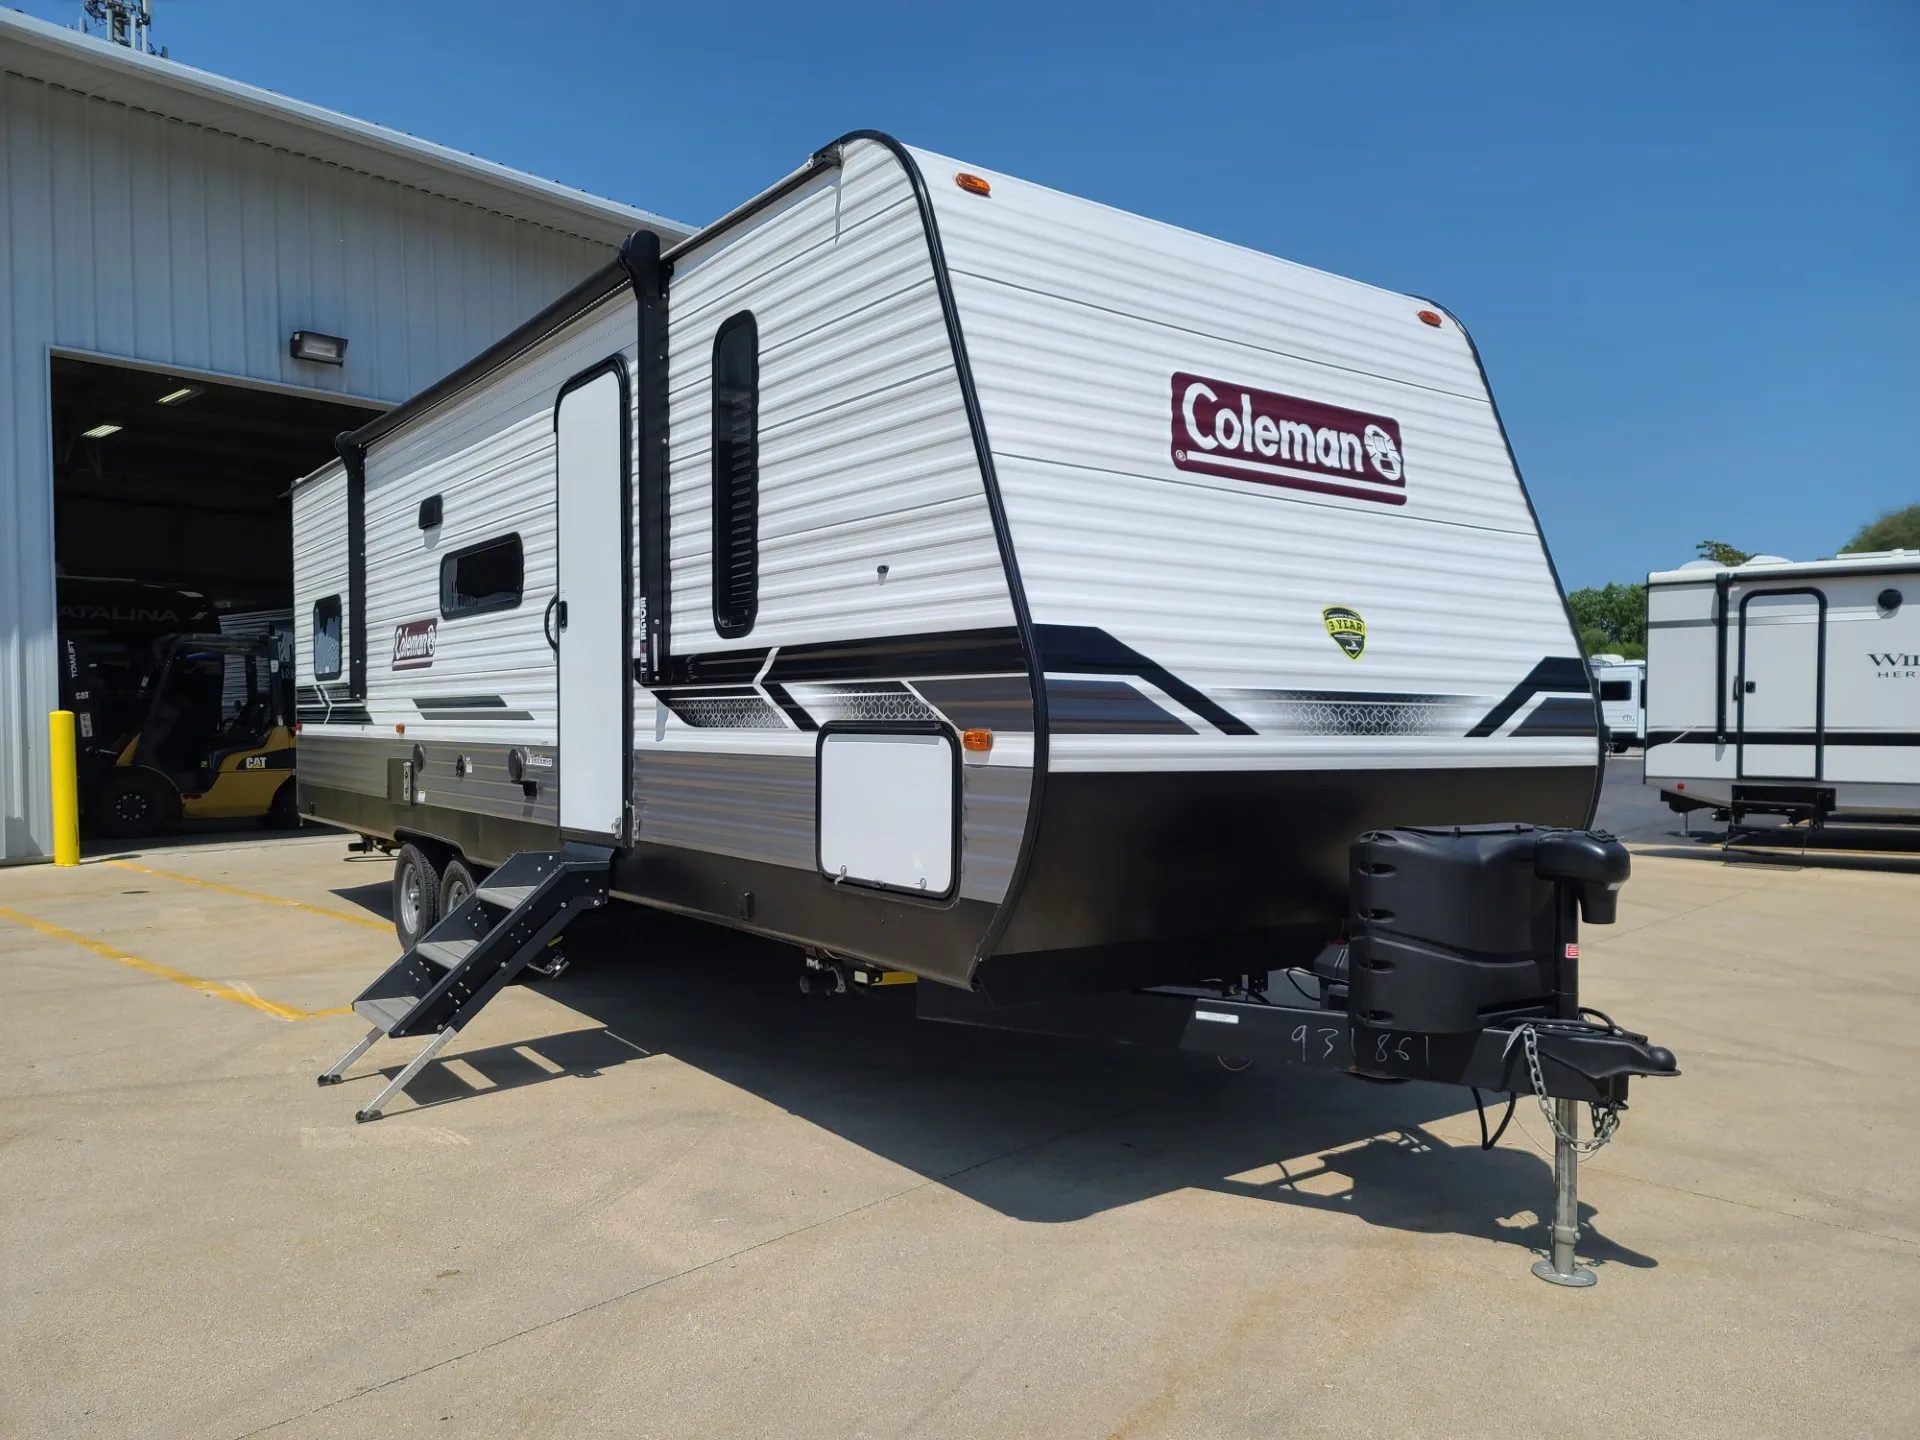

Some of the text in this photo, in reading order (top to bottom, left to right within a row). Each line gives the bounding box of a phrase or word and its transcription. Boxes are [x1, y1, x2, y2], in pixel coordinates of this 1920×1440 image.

[1182, 382, 1364, 473] Coleman
[58, 604, 181, 624] ATALINA
[1336, 619, 1362, 632] YEAR
[395, 627, 428, 660] Coleman
[66, 639, 79, 679] TOWLIFT
[75, 691, 90, 700] CAT
[245, 756, 267, 769] CAT
